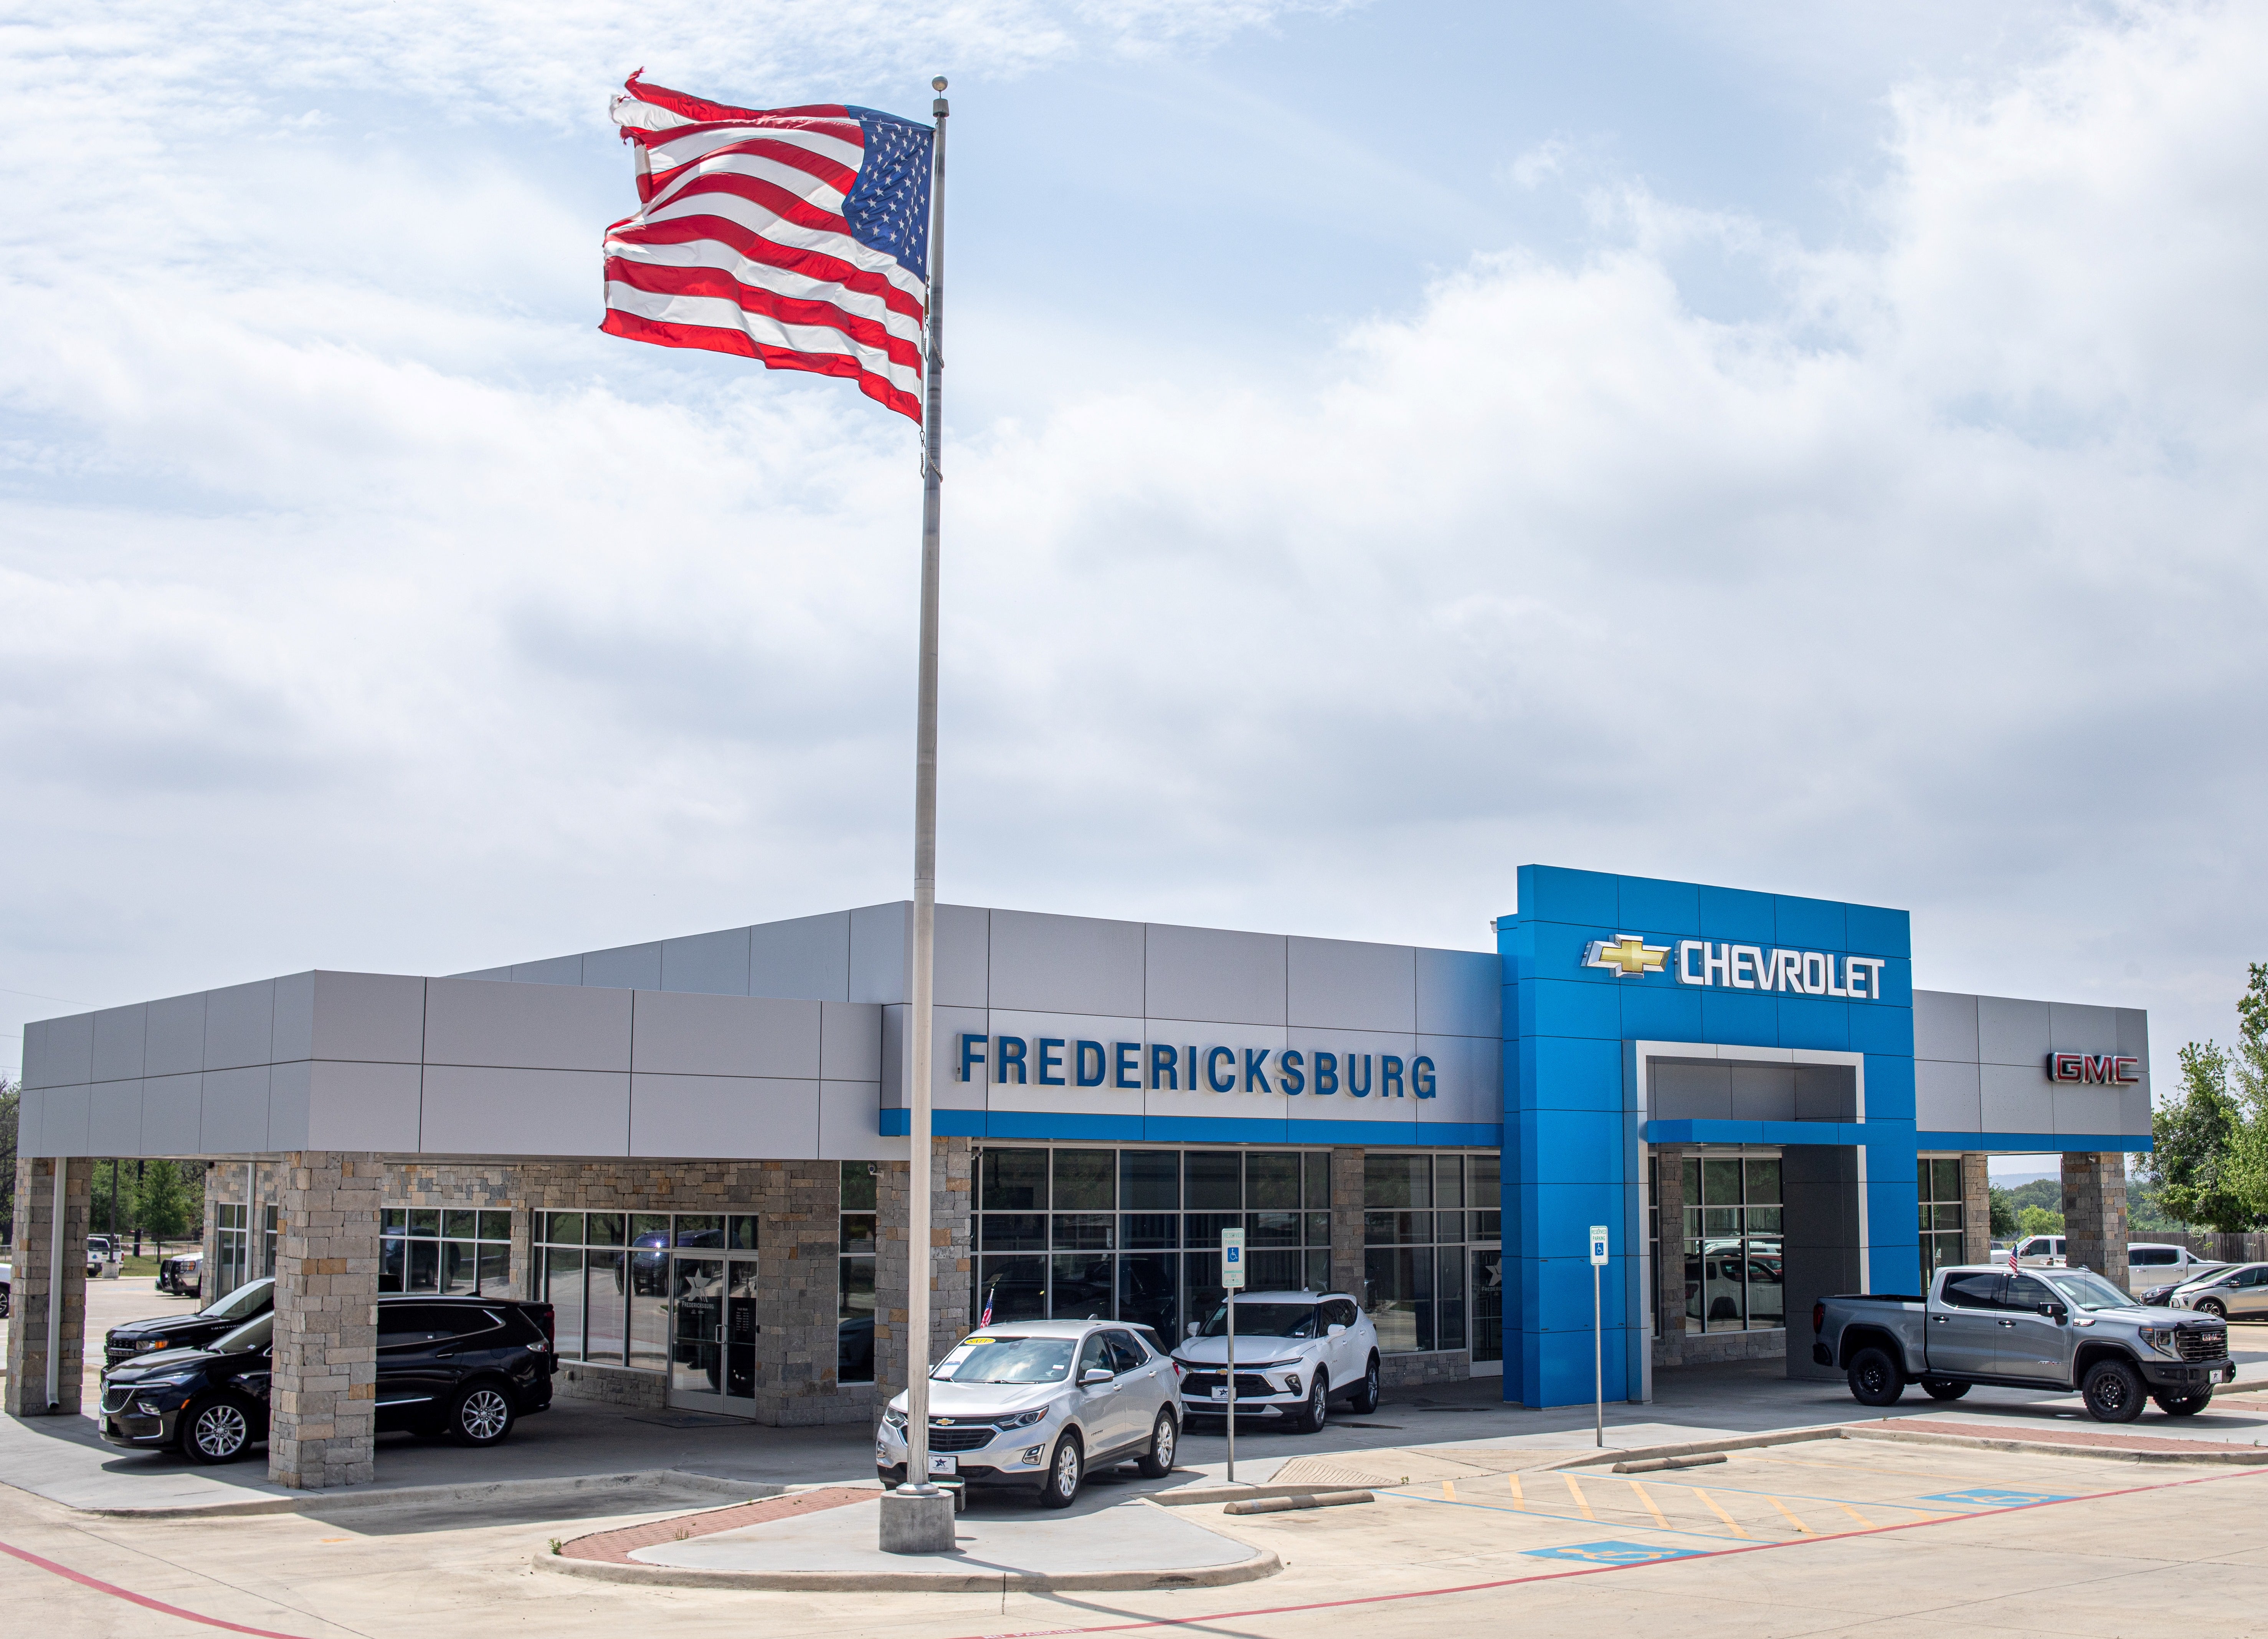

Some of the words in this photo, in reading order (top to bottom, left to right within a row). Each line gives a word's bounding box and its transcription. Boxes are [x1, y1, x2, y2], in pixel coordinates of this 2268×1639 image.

[1675, 940, 1885, 999] CHEVROLET
[956, 1034, 1437, 1098] FREDERICKSBURG
[2047, 1052, 2140, 1084] GMC
[682, 1300, 714, 1309] FREDERICKSBURG
[2202, 1333, 2221, 1341] GMC
[1013, 1629, 1085, 1637] PARKING
